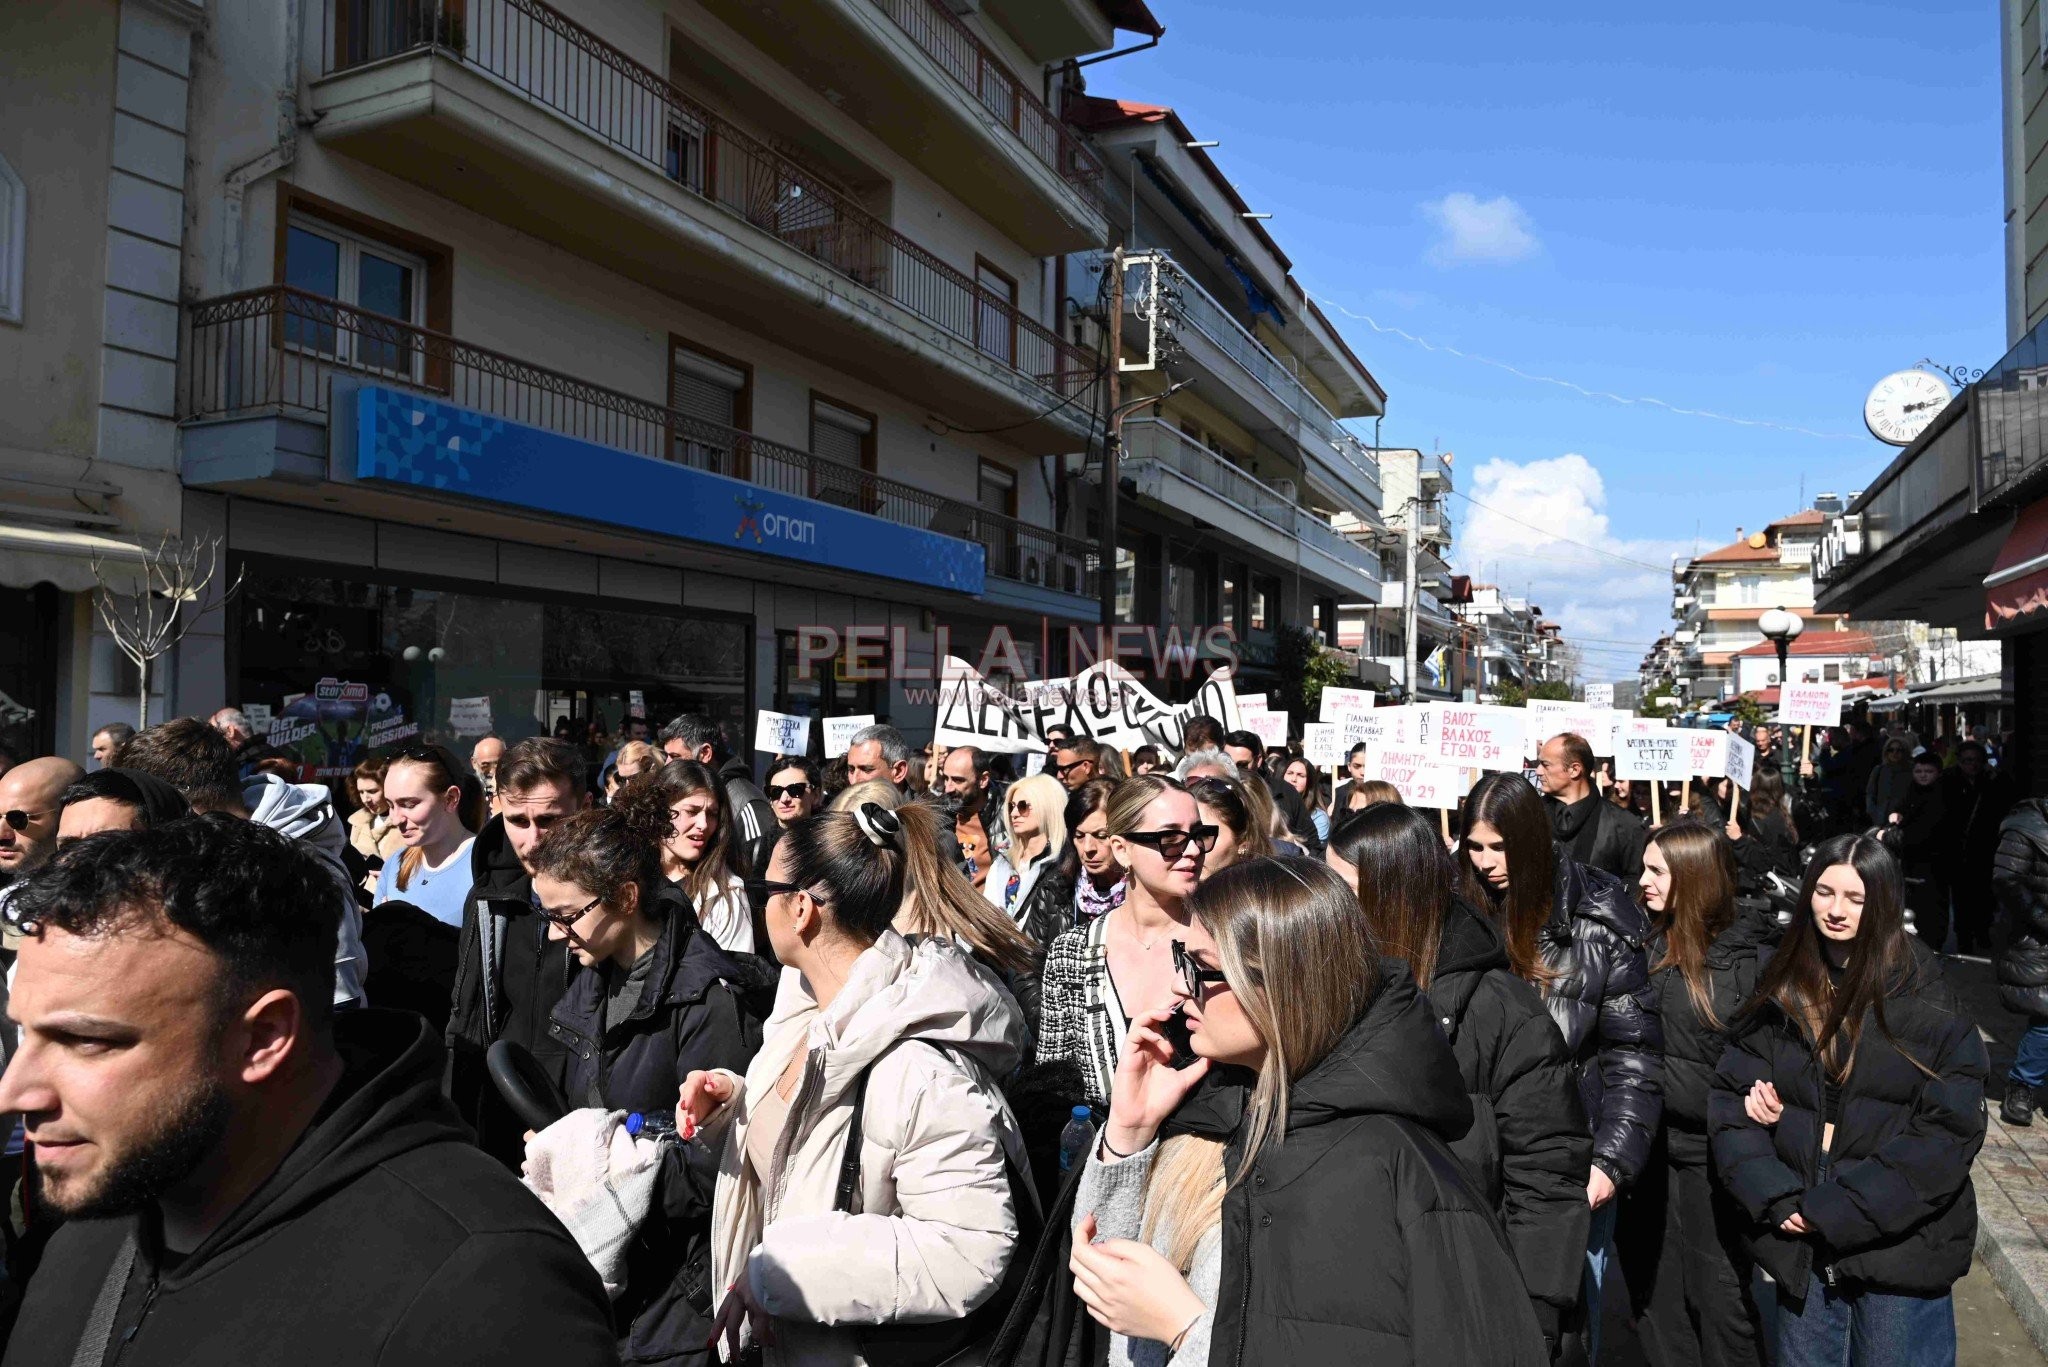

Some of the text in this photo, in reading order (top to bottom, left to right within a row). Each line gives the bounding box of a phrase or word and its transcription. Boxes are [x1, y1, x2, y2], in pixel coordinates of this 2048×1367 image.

[270, 716, 299, 734] BET
[1345, 713, 1380, 725] ΓΙΑΝΝΗΣ
[1443, 710, 1478, 727] ΒΑΙΟΣ
[368, 722, 419, 748] MISSIONS
[1314, 728, 1335, 736] ΔΗΜΗ
[1441, 727, 1492, 744] ΒΛΑΧΟΣ
[786, 737, 795, 749] 21
[1440, 742, 1501, 760] ΕΤΩΝ 34
[1657, 761, 1668, 771] 52
[1691, 758, 1705, 770] 32
[1380, 767, 1416, 783] ΟΙΚΟΥ
[1417, 785, 1436, 799] 29
